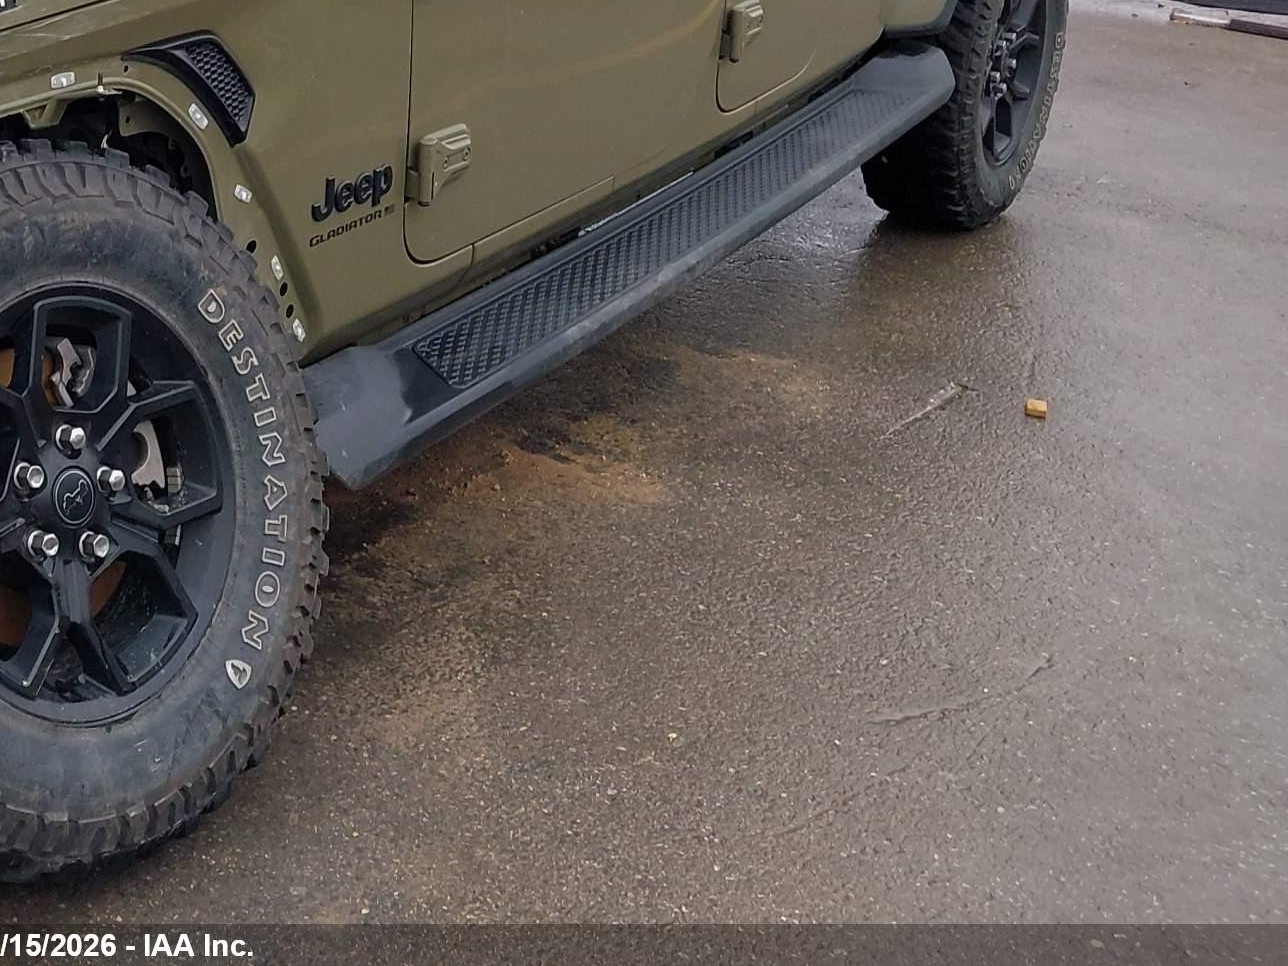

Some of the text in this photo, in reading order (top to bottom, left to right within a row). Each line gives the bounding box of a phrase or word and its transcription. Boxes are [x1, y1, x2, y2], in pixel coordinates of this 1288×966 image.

[311, 164, 393, 222] Jeep
[309, 209, 381, 248] GLADIATOR
[198, 289, 289, 649] DESTINATION
